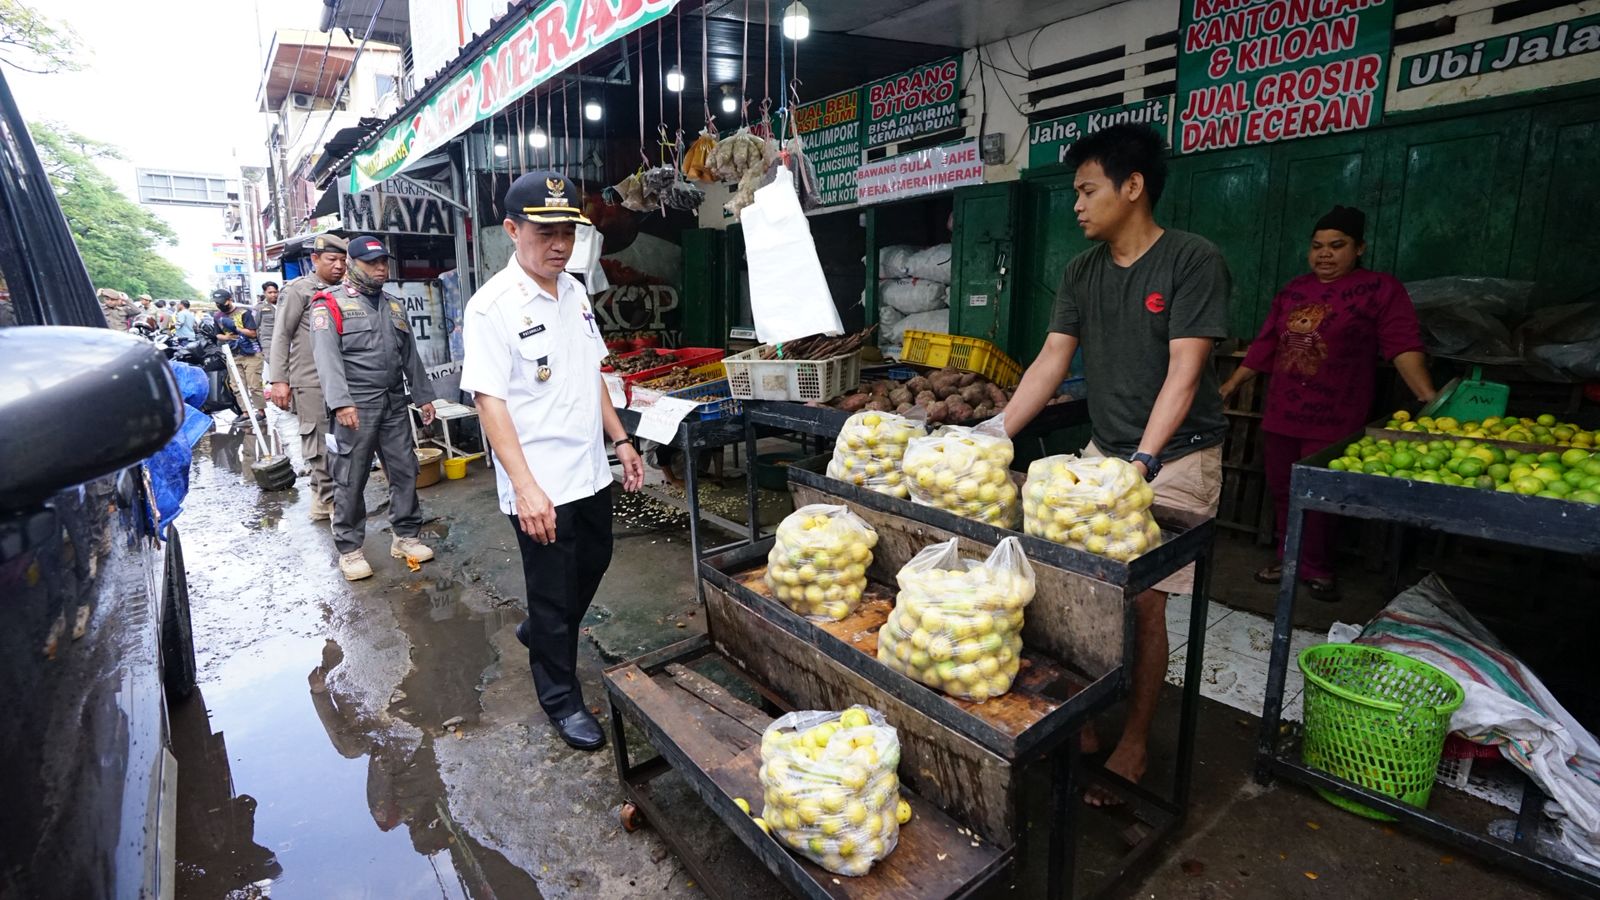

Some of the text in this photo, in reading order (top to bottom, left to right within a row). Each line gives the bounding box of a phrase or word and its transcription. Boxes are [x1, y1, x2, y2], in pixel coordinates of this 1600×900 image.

[1186, 0, 1385, 53] KANTONG
[1208, 15, 1359, 78] & KILOAN
[1409, 42, 1486, 86] Ubi
[869, 60, 957, 104] BARANG
[1181, 54, 1382, 122] JUAL GROSIR
[794, 91, 858, 122] UAL BELI
[871, 81, 954, 120] DITOKO
[822, 106, 857, 127] BUMI
[868, 102, 956, 135] BISA DIKIRIM
[868, 114, 955, 145] KEMANAPUN
[1182, 93, 1373, 152] DAN ECERAN
[801, 121, 860, 151] KAL/IMPORT
[1030, 121, 1081, 145] Jahe,
[817, 155, 860, 174] LANGSUNG
[820, 141, 859, 161] LANGSUNG
[858, 149, 976, 181] BAWANG GULA JAHE
[938, 166, 983, 186] MERAH
[820, 187, 859, 205] UAR KOTA
